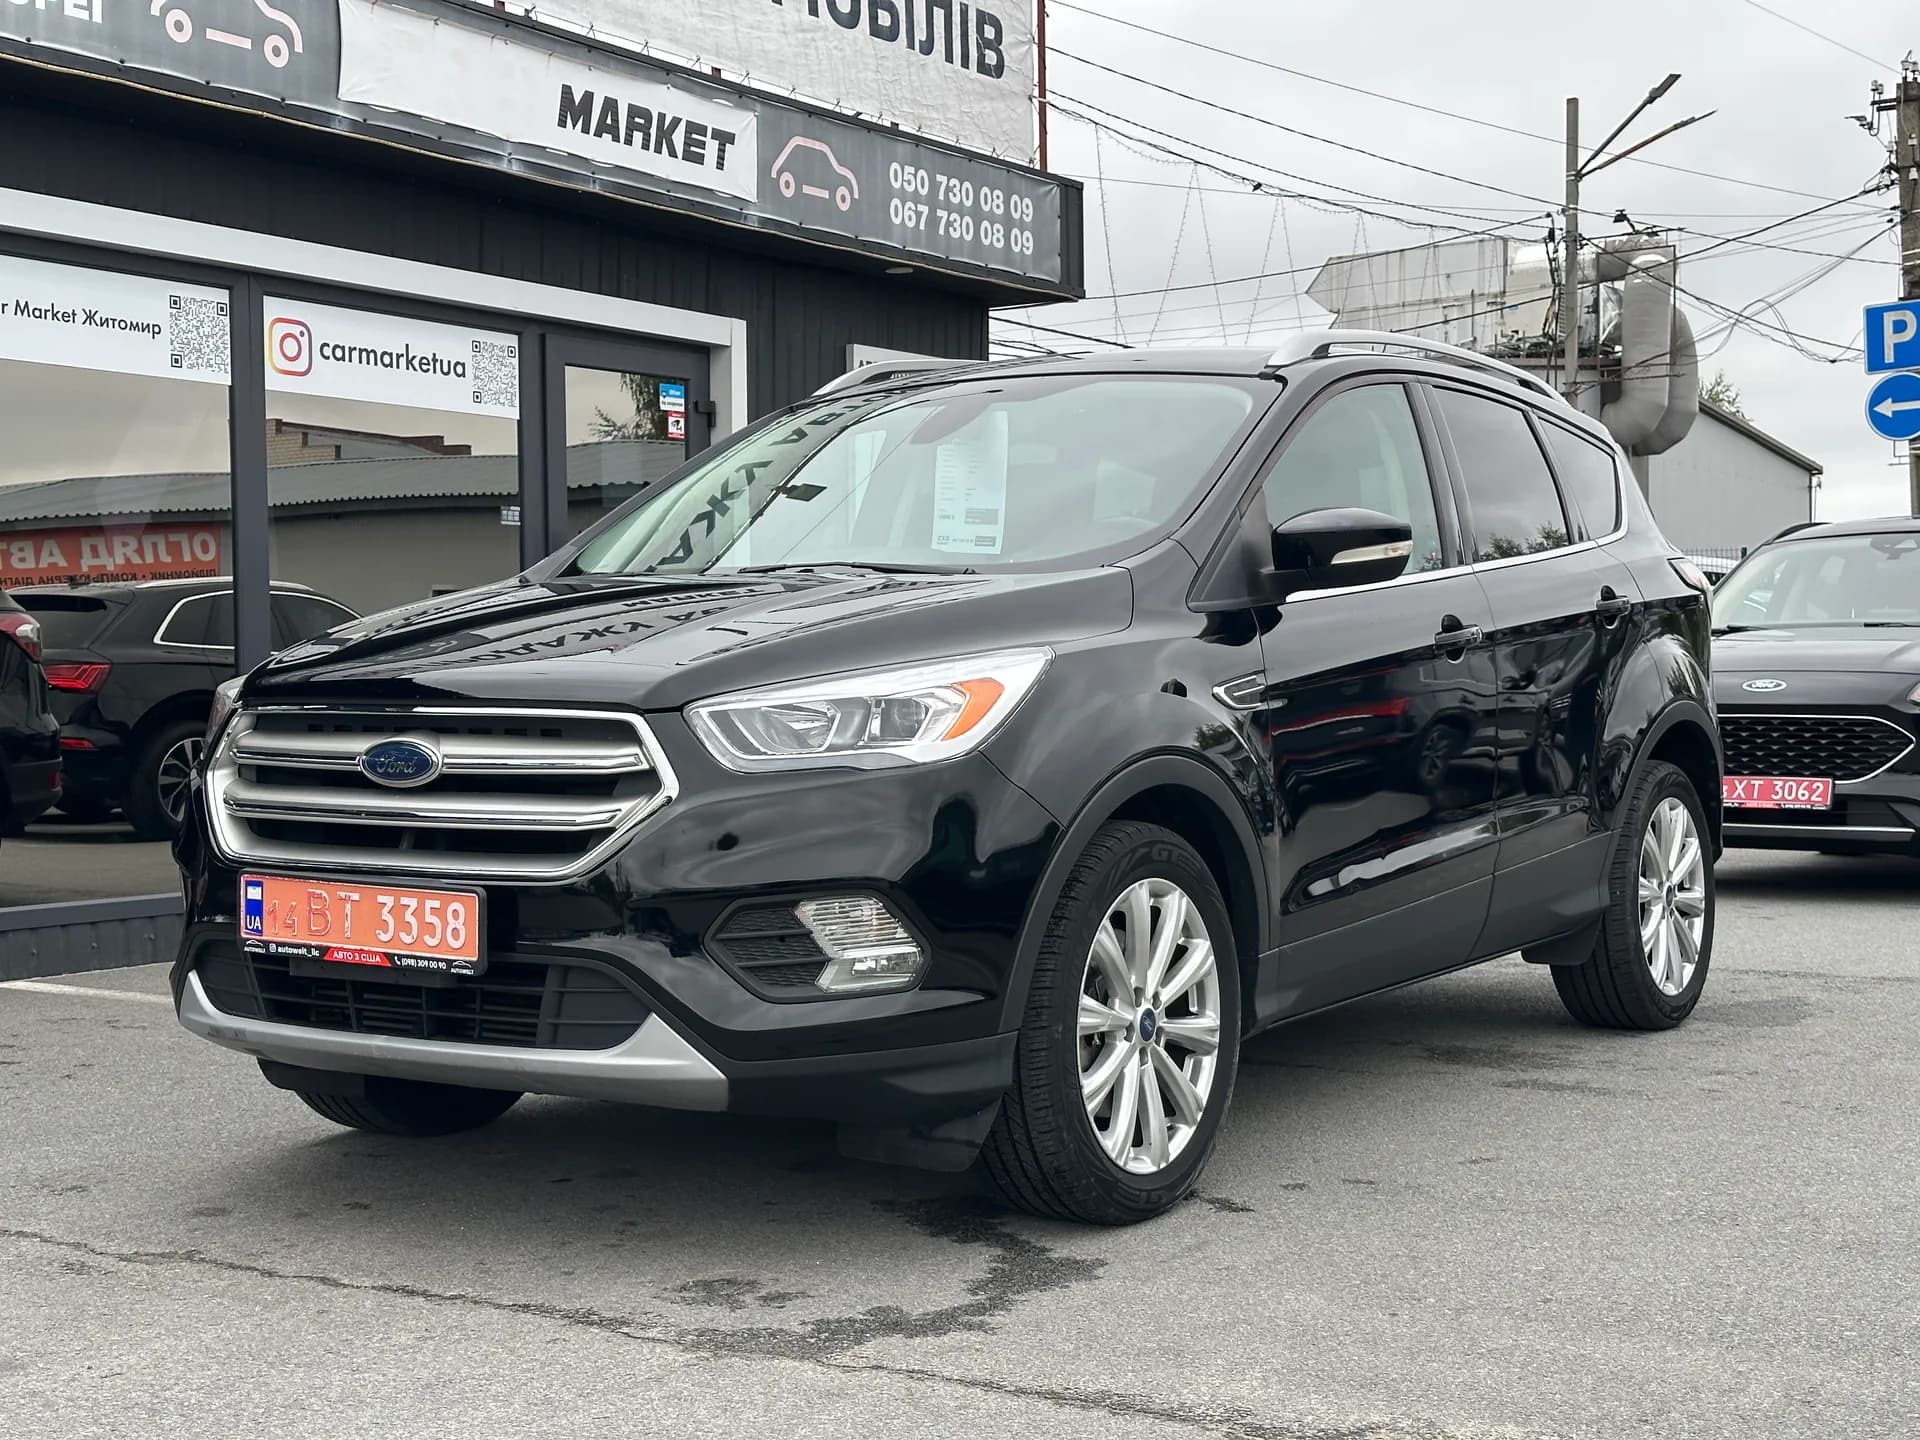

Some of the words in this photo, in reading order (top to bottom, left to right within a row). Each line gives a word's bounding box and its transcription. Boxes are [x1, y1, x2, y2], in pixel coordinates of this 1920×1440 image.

[557, 83, 736, 171] MARKET
[889, 162, 929, 196] 050
[936, 174, 974, 207] 730
[980, 186, 1004, 215] 08
[1010, 194, 1034, 222] 09
[889, 198, 929, 231] 067
[936, 209, 974, 241] 730
[980, 220, 1005, 248] 08
[1010, 228, 1034, 255] 09
[14, 299, 77, 324] Market
[82, 308, 162, 339] Житомир
[1883, 310, 1917, 363] P
[319, 342, 466, 378] carmarketua
[376, 751, 418, 774] Ford
[1771, 781, 1825, 801] 3062
[246, 914, 262, 930] UA
[375, 894, 467, 949] 3358
